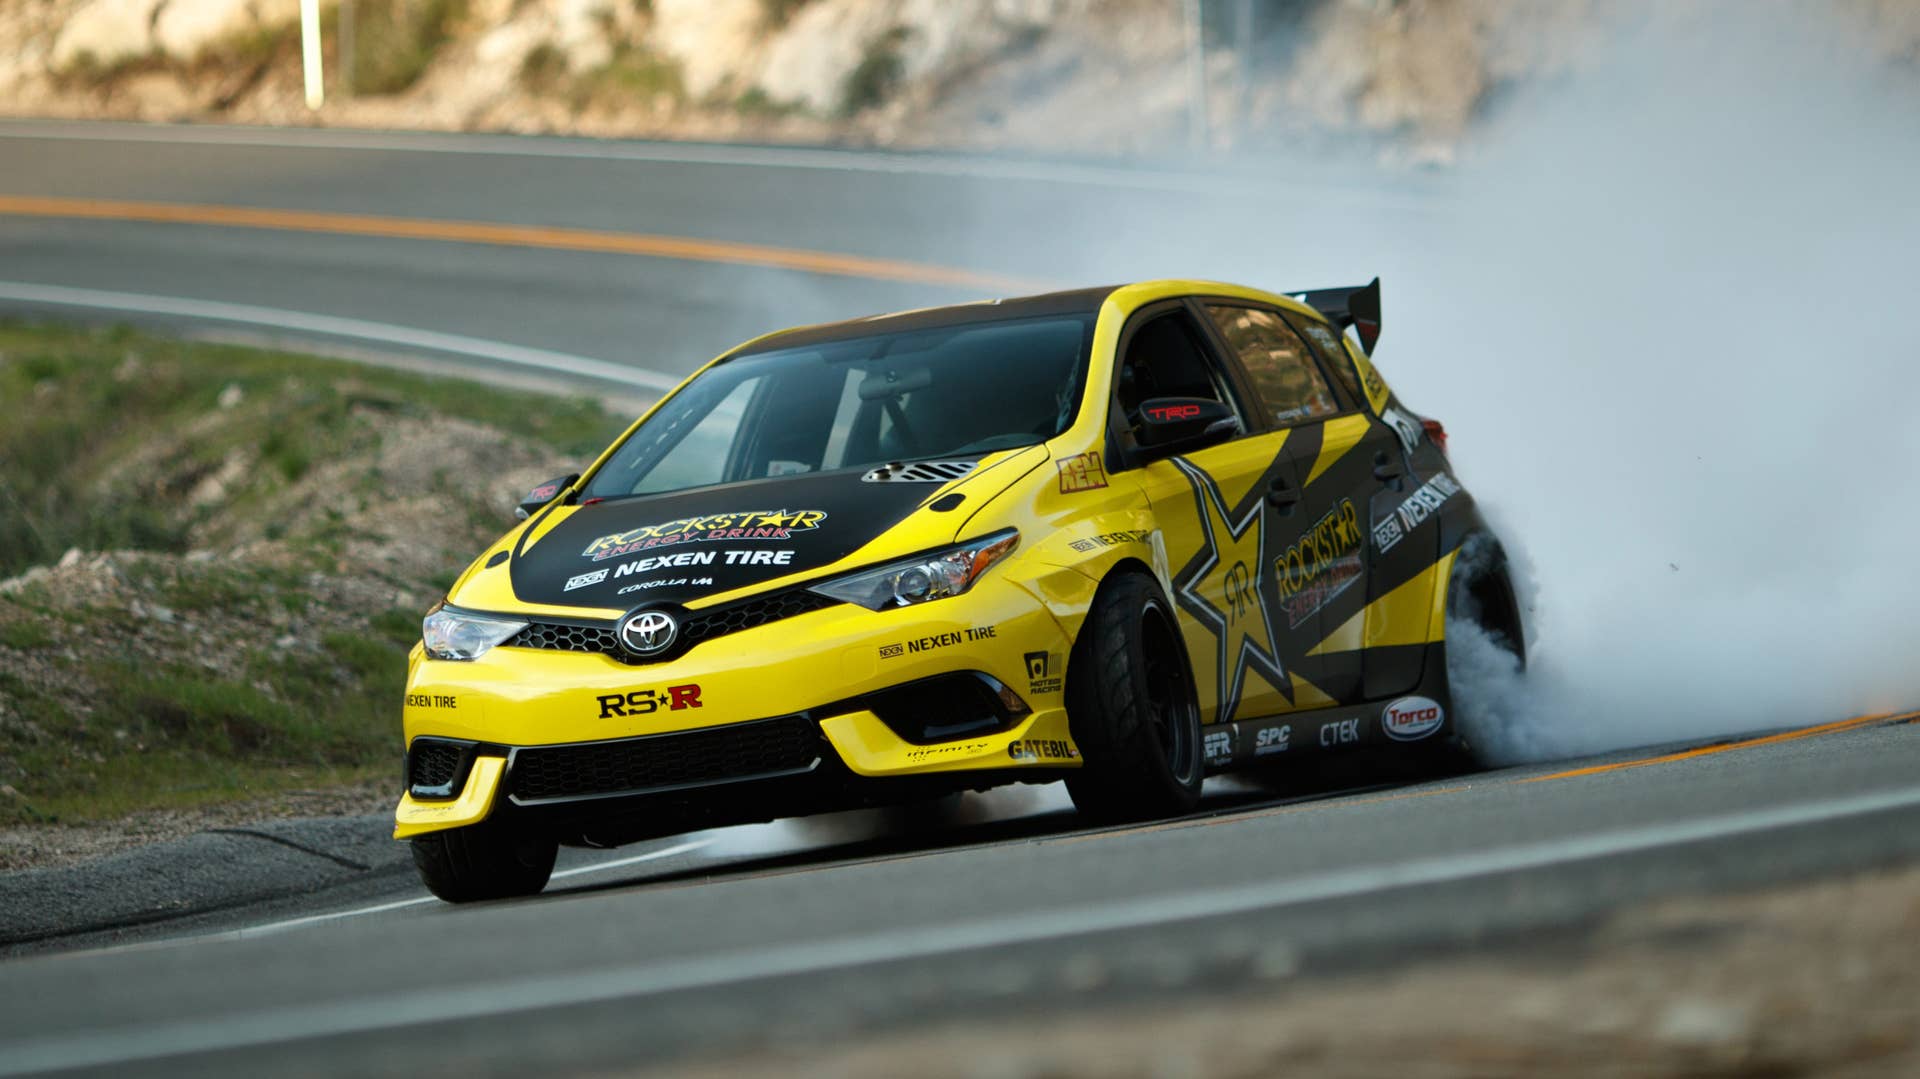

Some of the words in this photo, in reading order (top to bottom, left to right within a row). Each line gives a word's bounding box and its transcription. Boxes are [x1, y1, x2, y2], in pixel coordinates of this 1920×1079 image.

[1148, 405, 1201, 421] TRD
[595, 531, 699, 560] ENERGY
[706, 527, 793, 540] DRINK
[614, 551, 717, 578] NEXEN
[724, 551, 795, 566] TIRE
[617, 578, 688, 595] COROLLA
[907, 631, 962, 653] NEXEN
[964, 625, 997, 642] TIRE
[433, 695, 457, 709] TIRE
[1389, 707, 1438, 727] Torco
[1256, 725, 1291, 747] SPC
[1320, 718, 1359, 746] CTEK
[1008, 740, 1074, 760] GATEBIL
[1204, 732, 1232, 758] EFR
